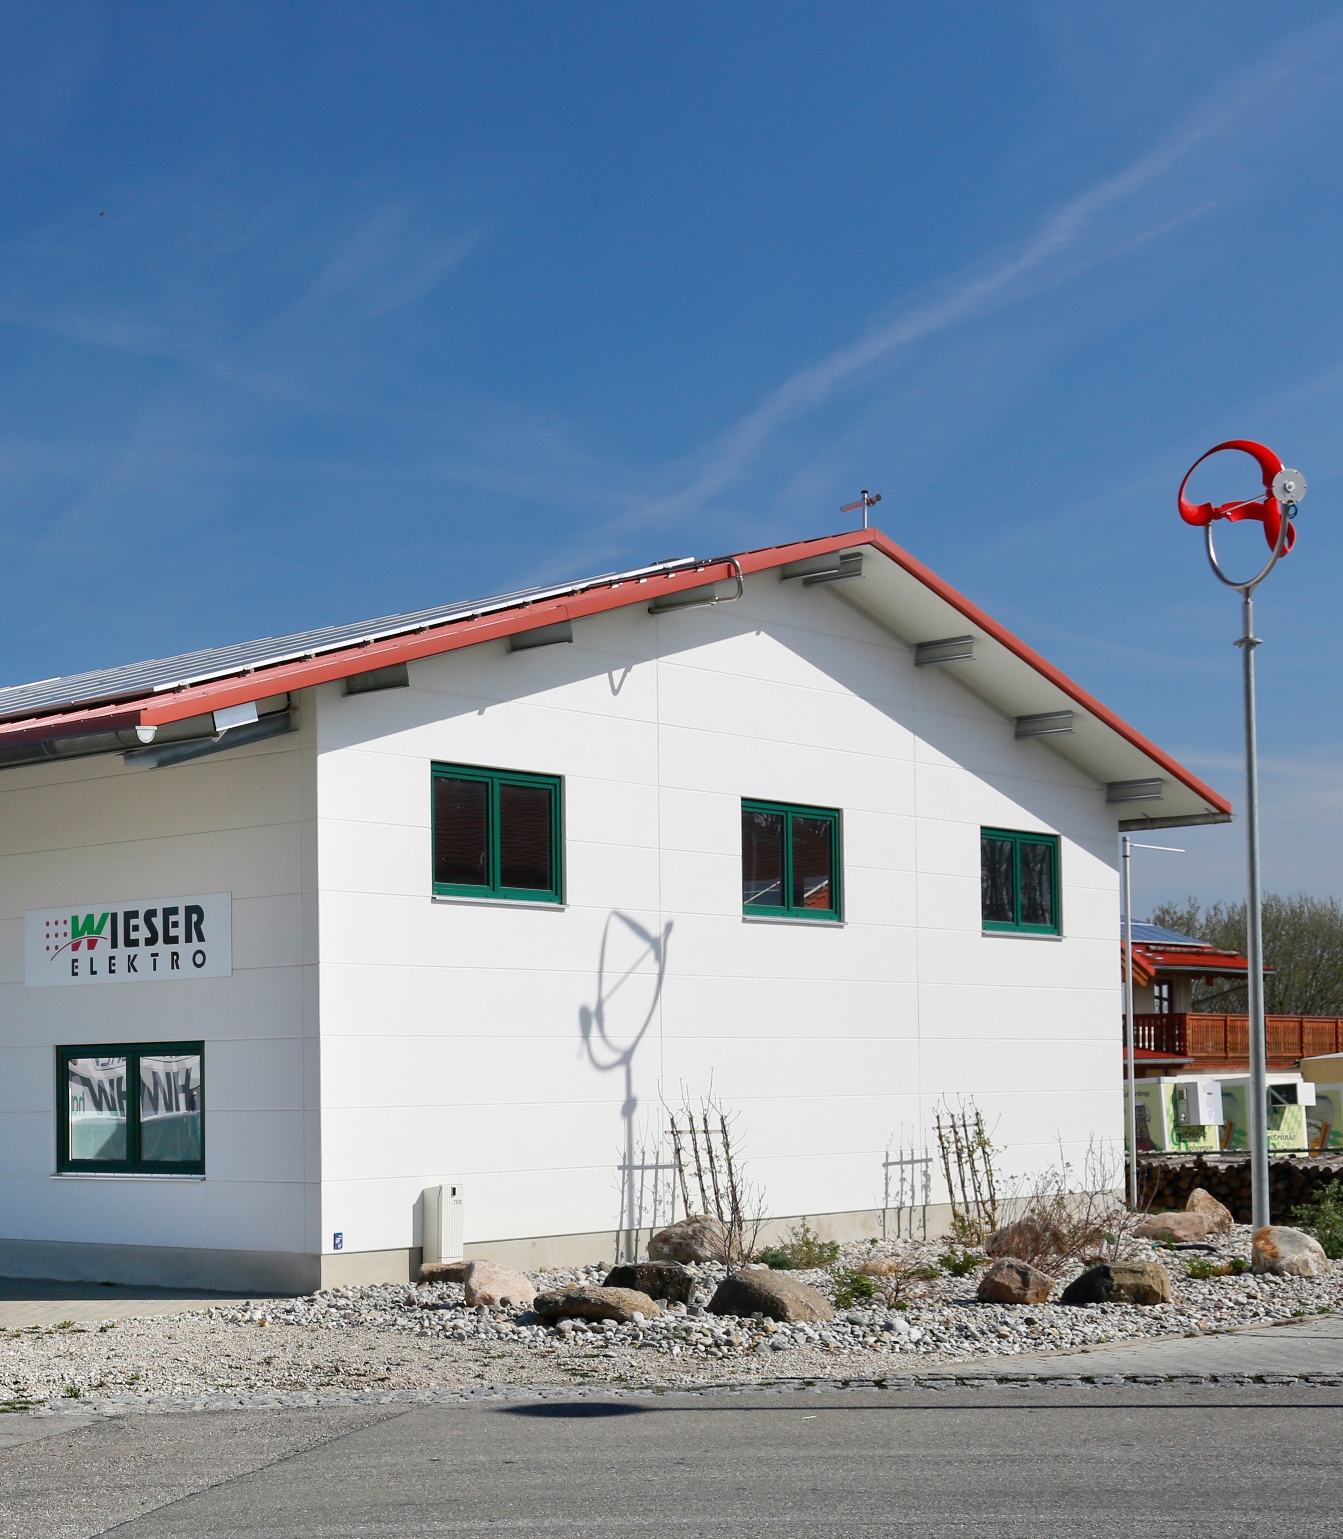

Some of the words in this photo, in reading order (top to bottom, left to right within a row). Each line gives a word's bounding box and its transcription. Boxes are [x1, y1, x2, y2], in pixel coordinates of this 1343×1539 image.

[71, 904, 206, 952] WIESER
[71, 949, 207, 977] ELEKTRO
[1267, 1131, 1297, 1142] etränke
